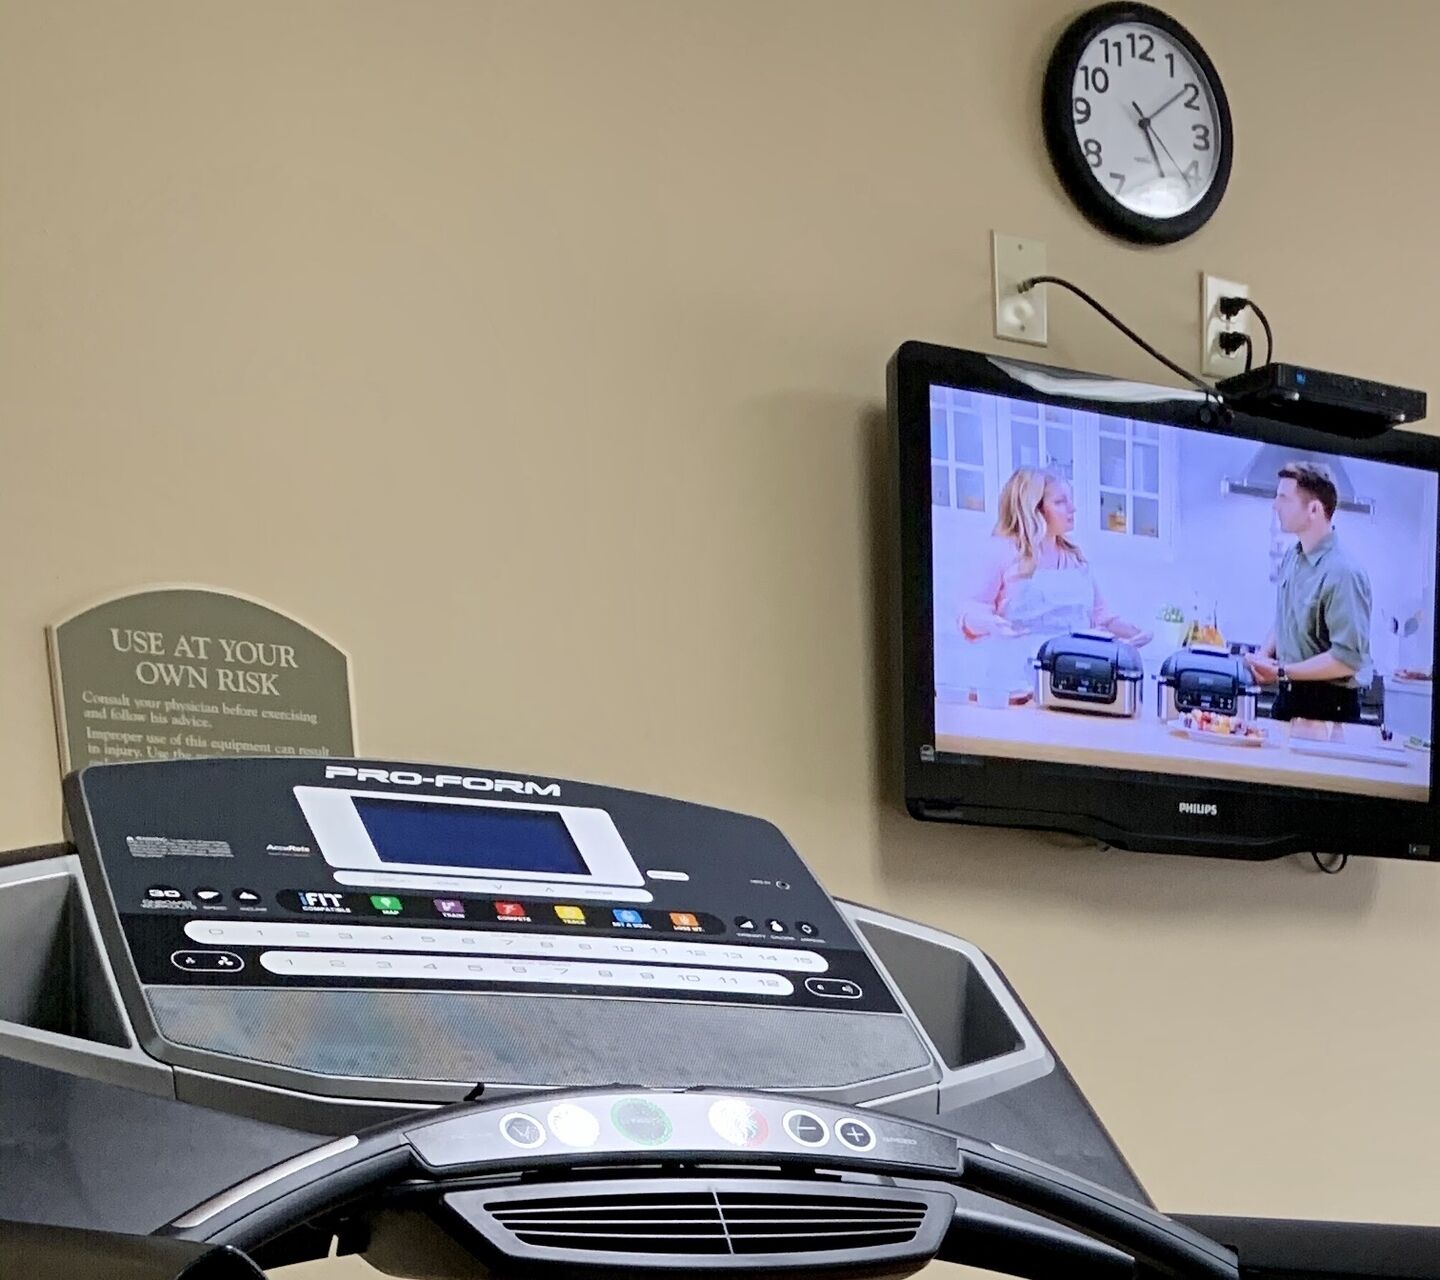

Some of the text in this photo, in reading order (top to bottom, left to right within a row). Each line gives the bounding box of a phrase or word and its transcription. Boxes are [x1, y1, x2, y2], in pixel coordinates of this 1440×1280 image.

[1100, 39, 1122, 67] 11
[1126, 33, 1155, 62] 12
[1080, 65, 1109, 93] 10
[1165, 53, 1174, 78] 1
[1075, 97, 1091, 124] 9
[1184, 83, 1200, 111] 2
[1192, 124, 1210, 151] 3
[1083, 139, 1102, 167] 8
[1109, 172, 1126, 195] 7
[110, 628, 298, 668] USE AT YOUR
[136, 661, 280, 696] OWN RISK
[82, 691, 318, 724] Consult your physician before exercising
[84, 708, 213, 728] and follow his advice.
[86, 727, 329, 757] Improper use of this equipment can result
[88, 743, 99, 754] in
[104, 744, 142, 758] injury.
[146, 747, 169, 759] Use
[325, 766, 561, 797] PRO-FORM
[1178, 802, 1218, 816] PHILIPS
